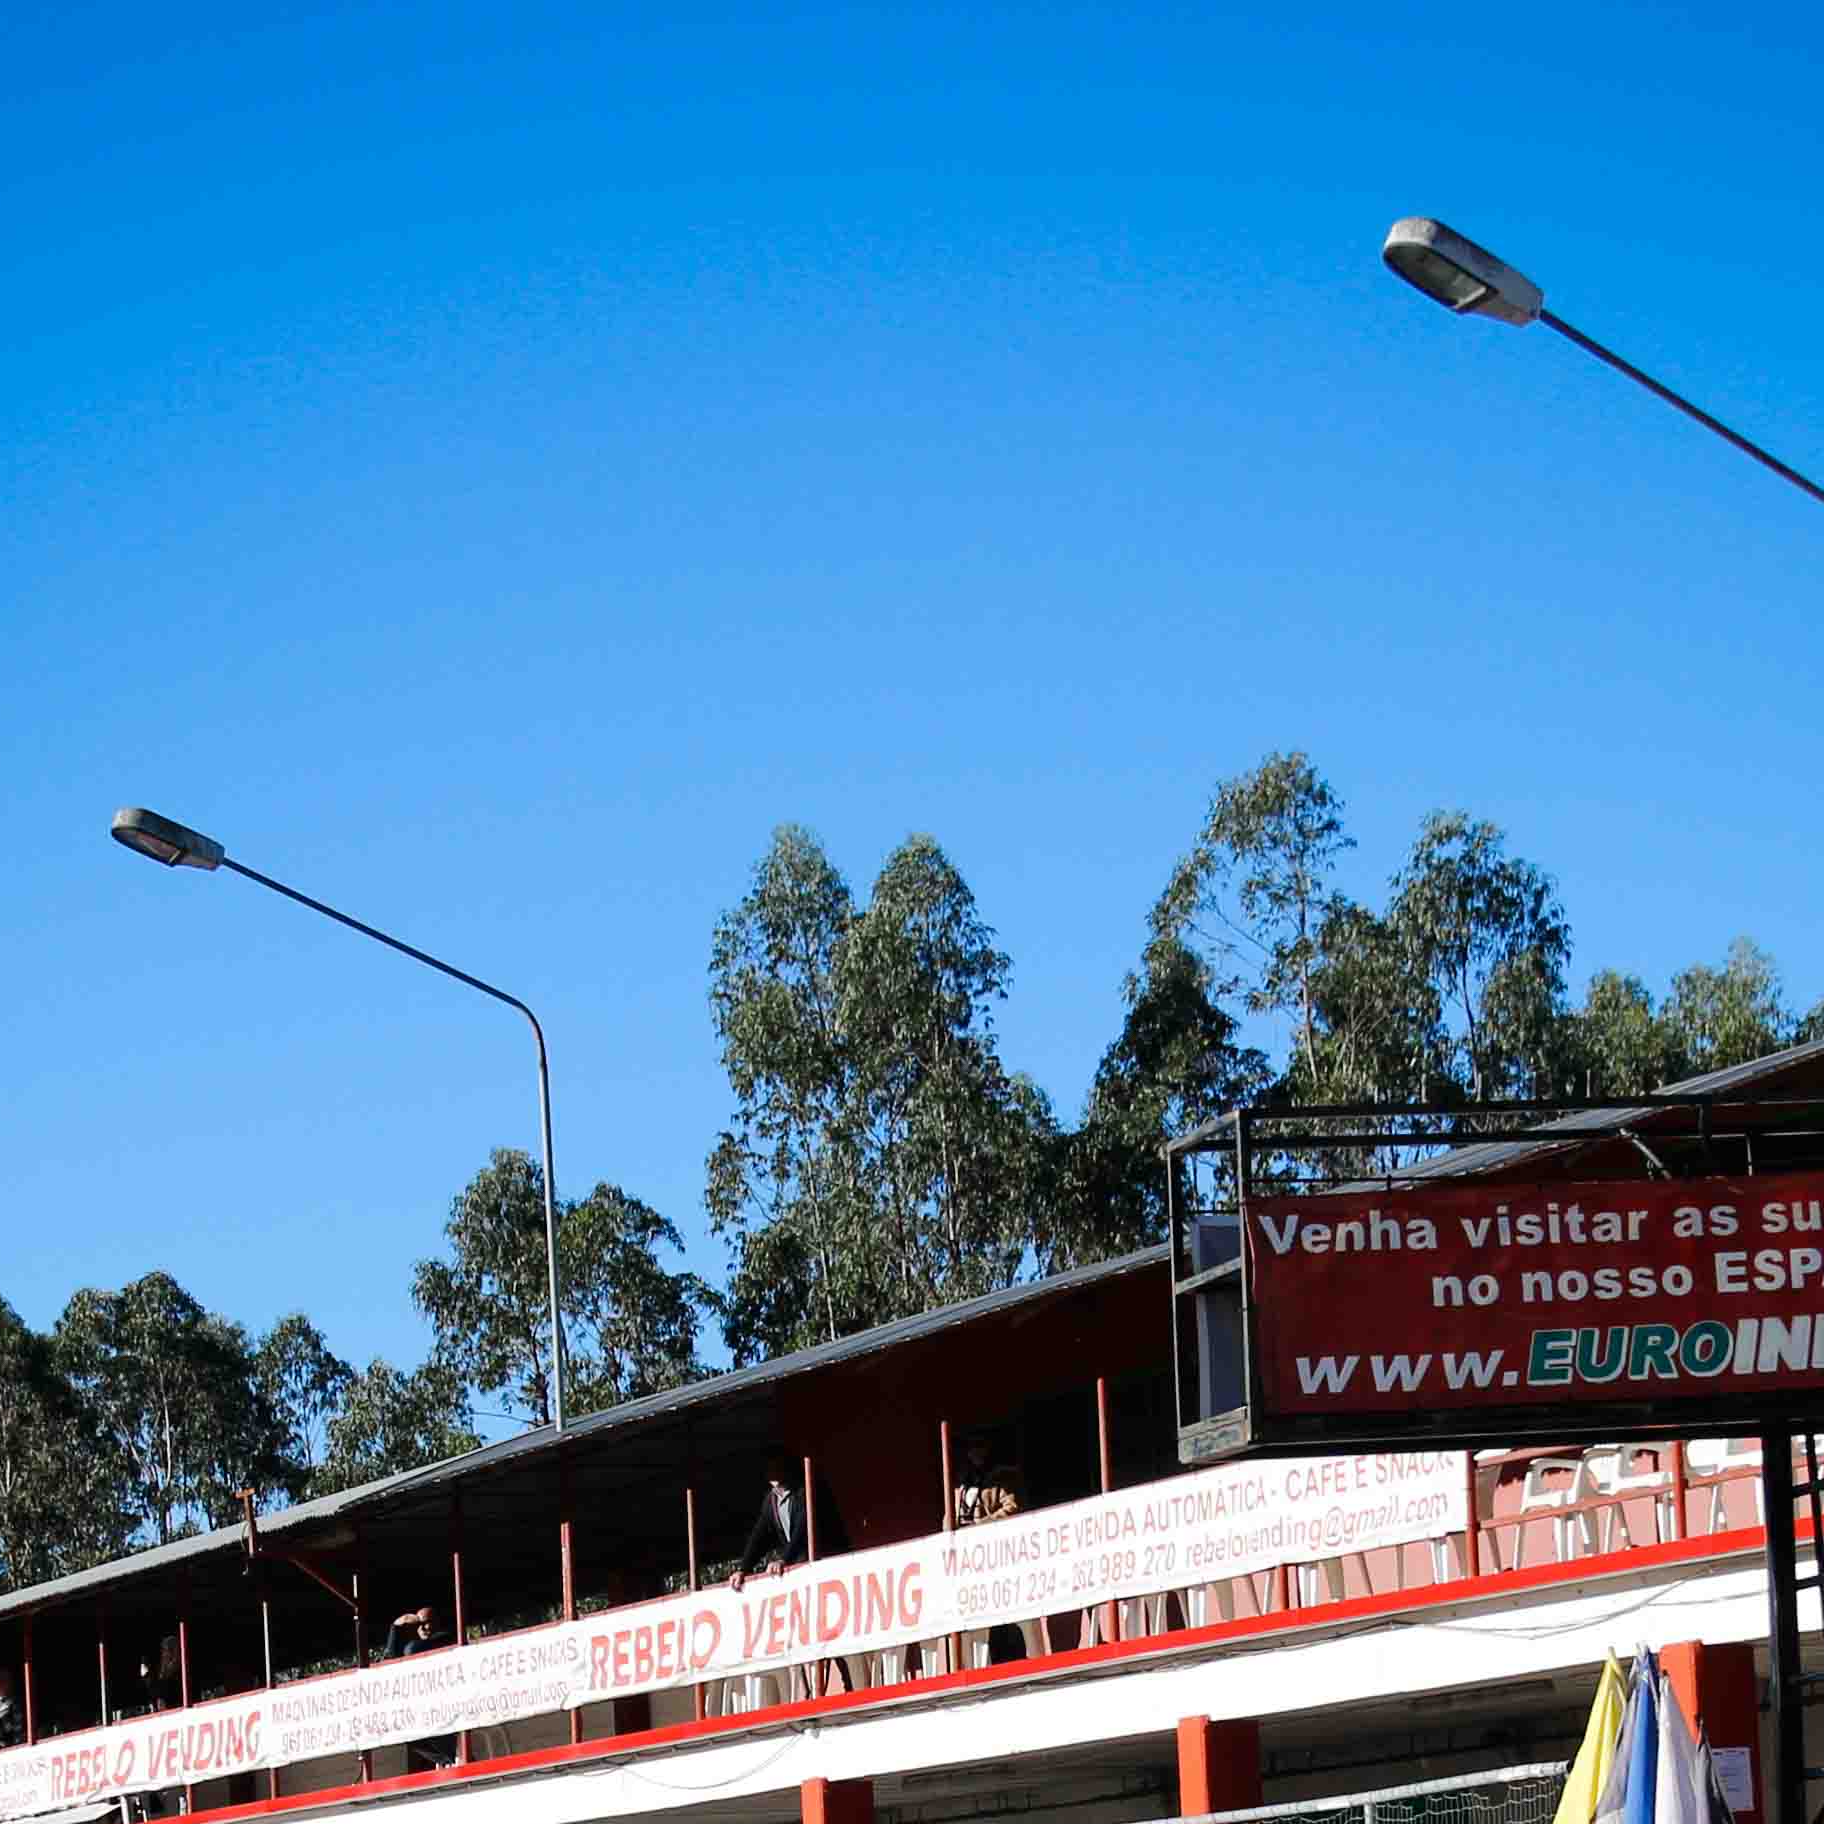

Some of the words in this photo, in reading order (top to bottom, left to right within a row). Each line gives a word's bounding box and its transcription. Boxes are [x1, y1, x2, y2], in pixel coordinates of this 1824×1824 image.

[1258, 1210, 1437, 1256] Venha
[1459, 1202, 1649, 1248] visitar
[1672, 1202, 1739, 1239] as
[1432, 1268, 1500, 1309] no
[1521, 1261, 1694, 1304] nosso
[741, 1561, 923, 1659] VENDING
[147, 1710, 261, 1781] VENDING
